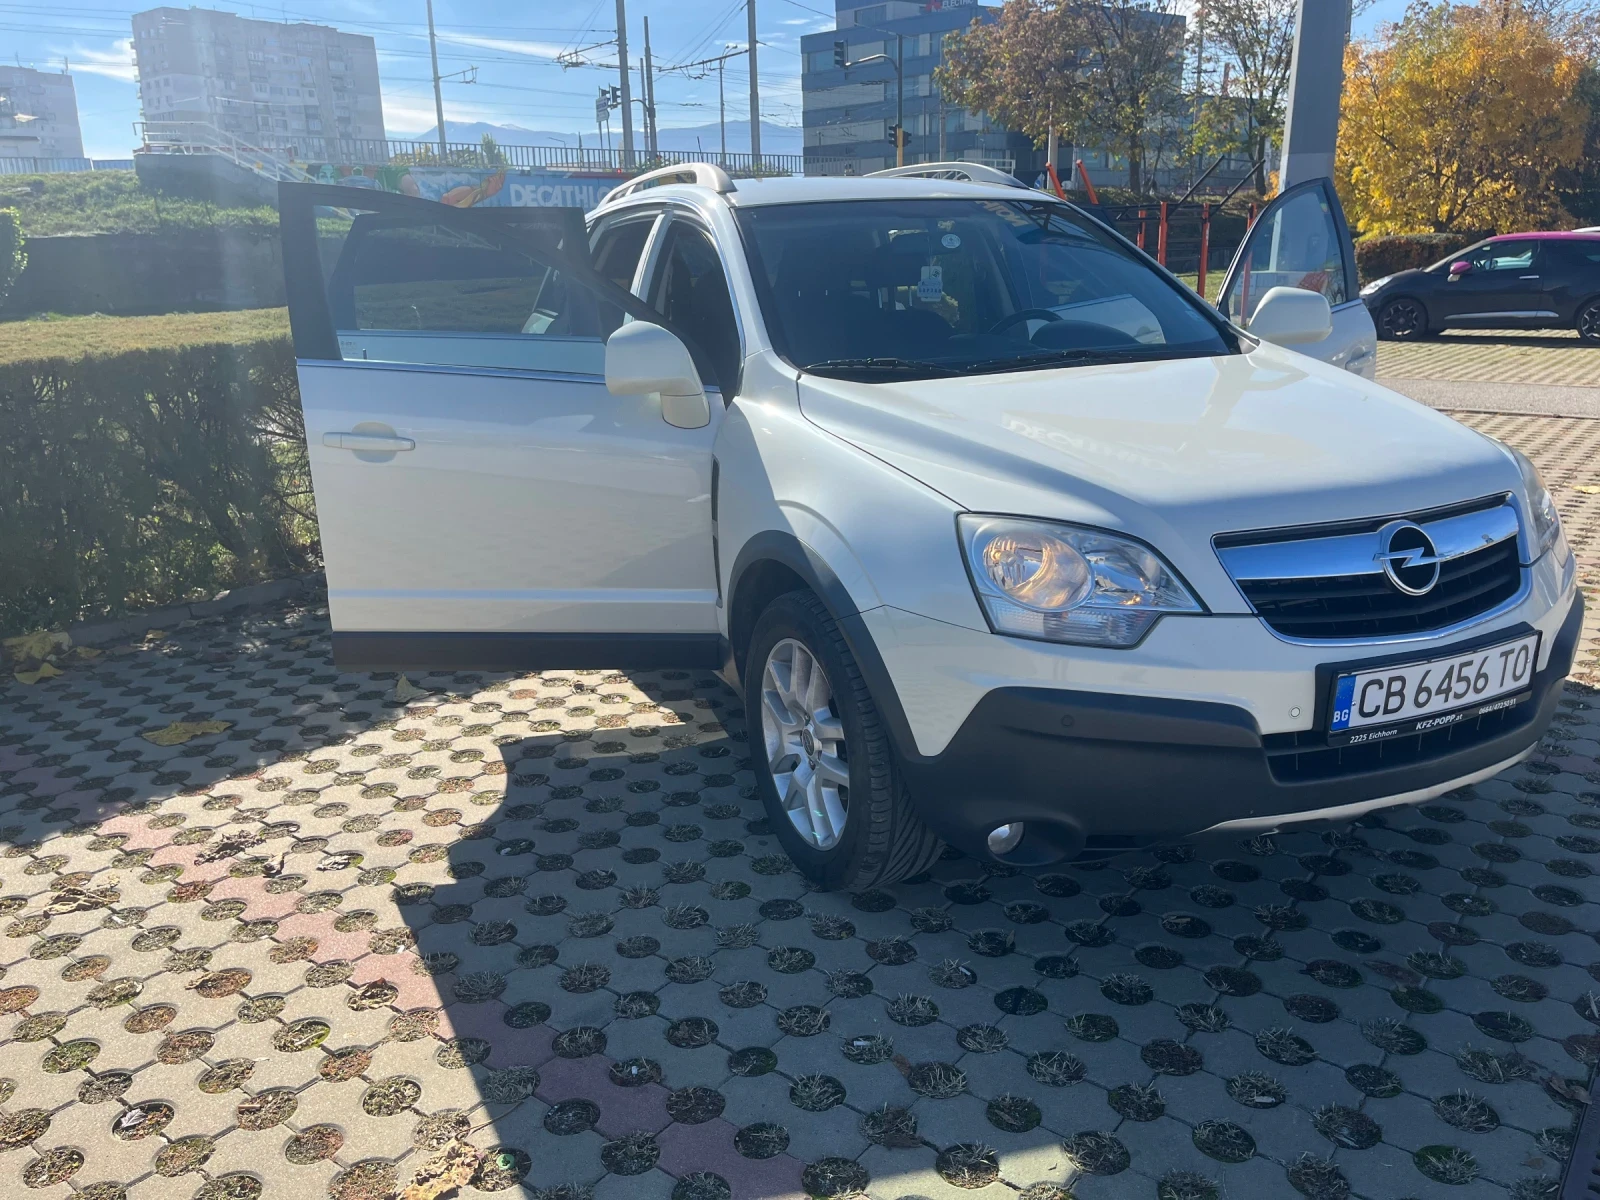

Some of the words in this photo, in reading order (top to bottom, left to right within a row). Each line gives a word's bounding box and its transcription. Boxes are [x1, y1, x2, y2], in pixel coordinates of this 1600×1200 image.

[509, 184, 614, 209] DECATHLO
[1358, 675, 1407, 719] CB
[1413, 656, 1490, 709] 6456
[1499, 644, 1530, 687] TO
[1333, 709, 1349, 723] BG
[1415, 713, 1463, 731] KFZ-POPP.at
[1349, 732, 1368, 744] 2225
[1368, 729, 1397, 740] Eichhorn
